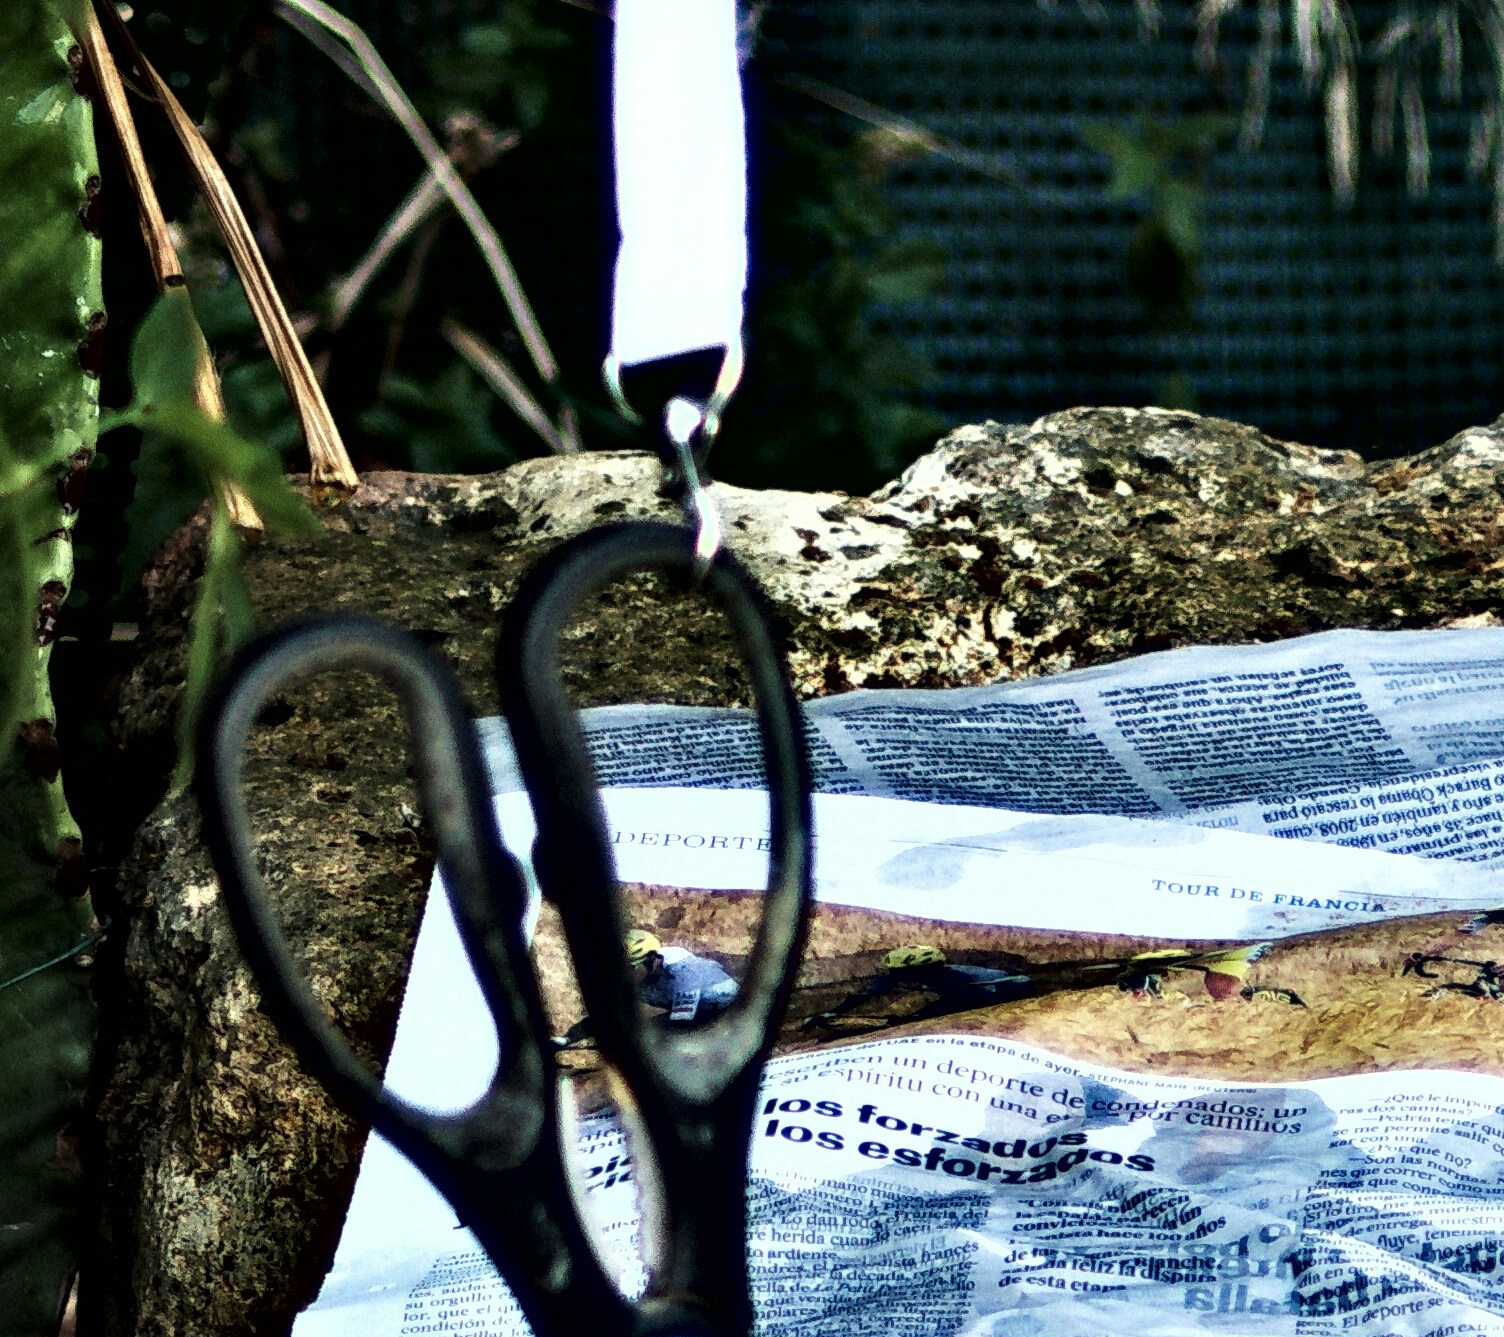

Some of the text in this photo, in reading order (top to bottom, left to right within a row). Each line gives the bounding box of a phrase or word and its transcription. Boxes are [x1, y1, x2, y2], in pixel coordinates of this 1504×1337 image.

[611, 829, 773, 853] DEPORTE
[1151, 878, 1387, 915] TOUR DE FRANCIA
[894, 1056, 927, 1071] un
[936, 1059, 1045, 1098] deporte
[1051, 1087, 1085, 1111] de
[932, 1082, 981, 1102] con
[988, 1096, 1039, 1121] una
[764, 1118, 1157, 1186] los esforzados
[857, 1103, 1089, 1161] forzados
